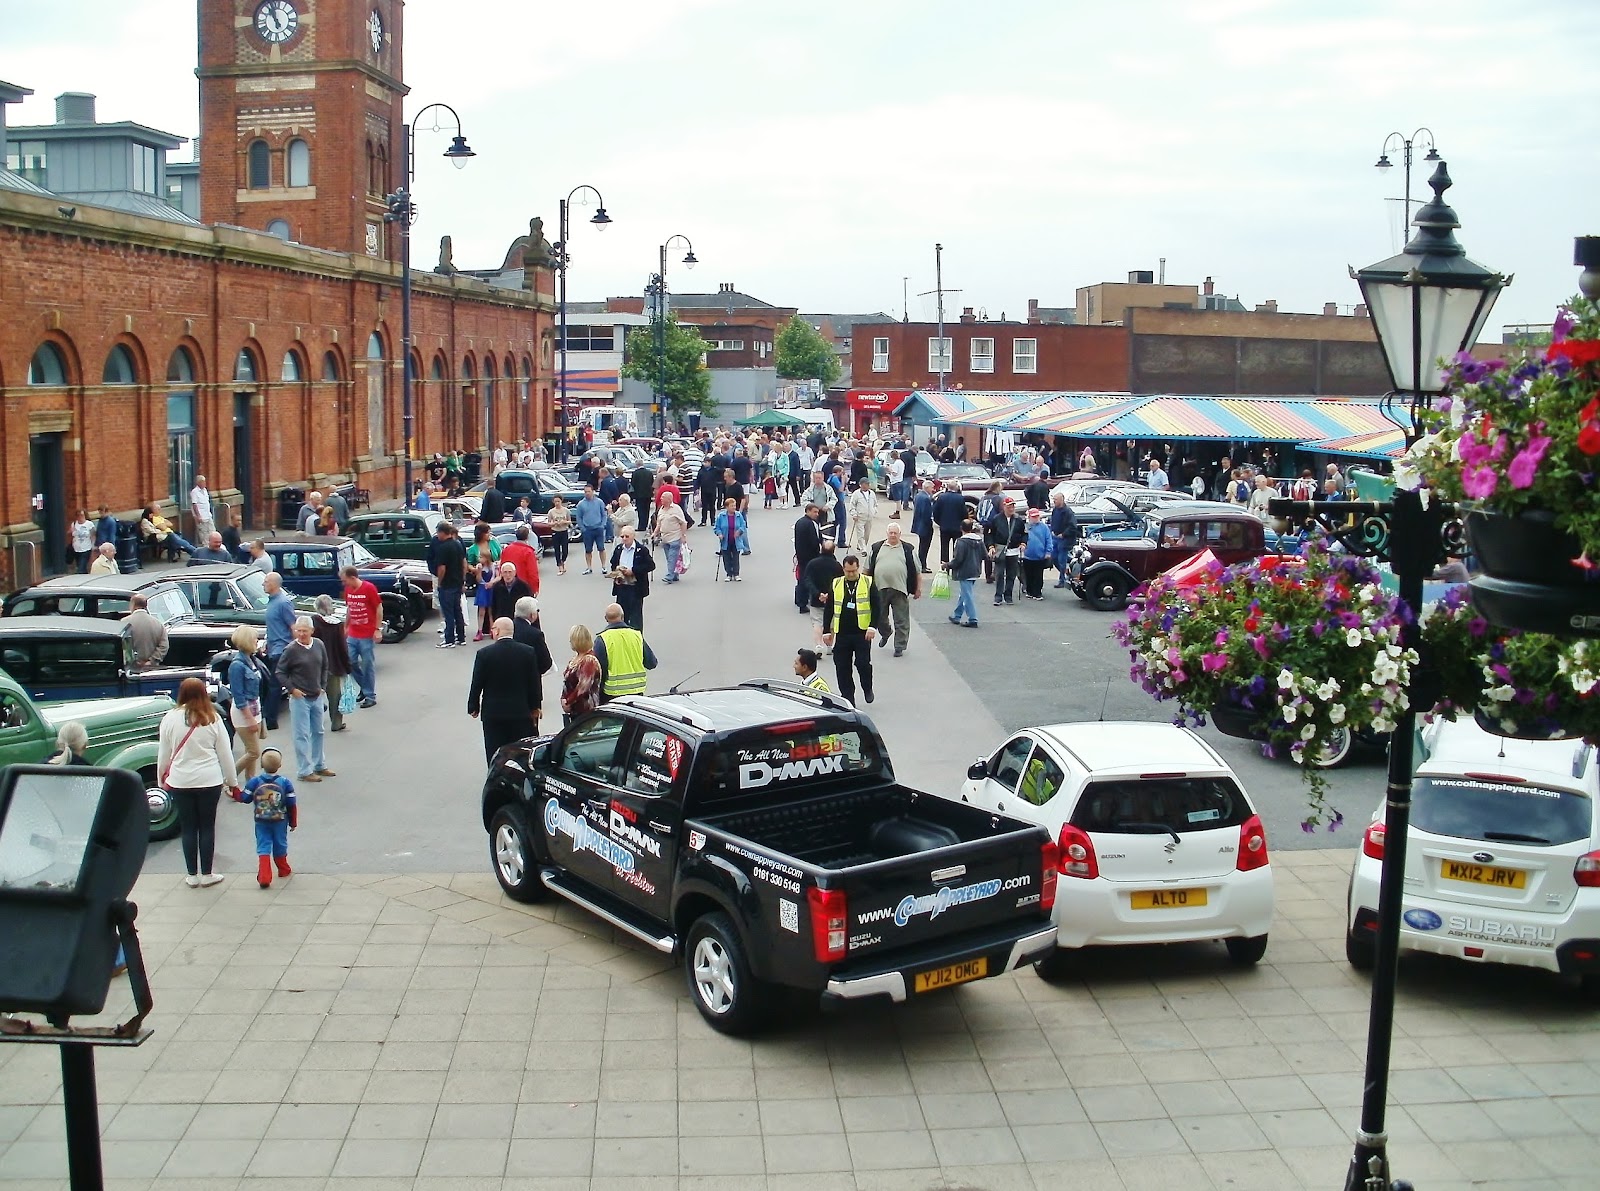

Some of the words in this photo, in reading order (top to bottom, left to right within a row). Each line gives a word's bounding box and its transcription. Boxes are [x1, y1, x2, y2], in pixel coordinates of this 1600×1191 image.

[737, 750, 754, 762] The
[754, 749, 771, 760] All
[771, 748, 790, 760] New
[790, 741, 844, 760] ISUZU
[739, 755, 844, 789] D-MAX
[544, 784, 562, 797] VEHICLE
[1431, 778, 1561, 799] www.colinappleyard.com
[580, 802, 590, 817] The
[588, 808, 599, 822] All
[598, 813, 609, 829] New
[611, 800, 638, 824] ISUZU
[690, 832, 698, 848] 5
[725, 842, 804, 880] www.colinappleyard.com
[753, 866, 769, 882] 0161
[770, 873, 783, 887] 330
[783, 879, 801, 894] 5148
[1449, 863, 1482, 883] MX12
[1486, 867, 1517, 886] JRV
[1152, 891, 1188, 906] ALTO
[848, 932, 872, 943] ISUZU
[1447, 929, 1555, 949] ASHTON-UNDER-LYNE
[1449, 915, 1557, 942] SUBARU
[923, 969, 952, 988] YJ12
[955, 961, 980, 980] OMG
